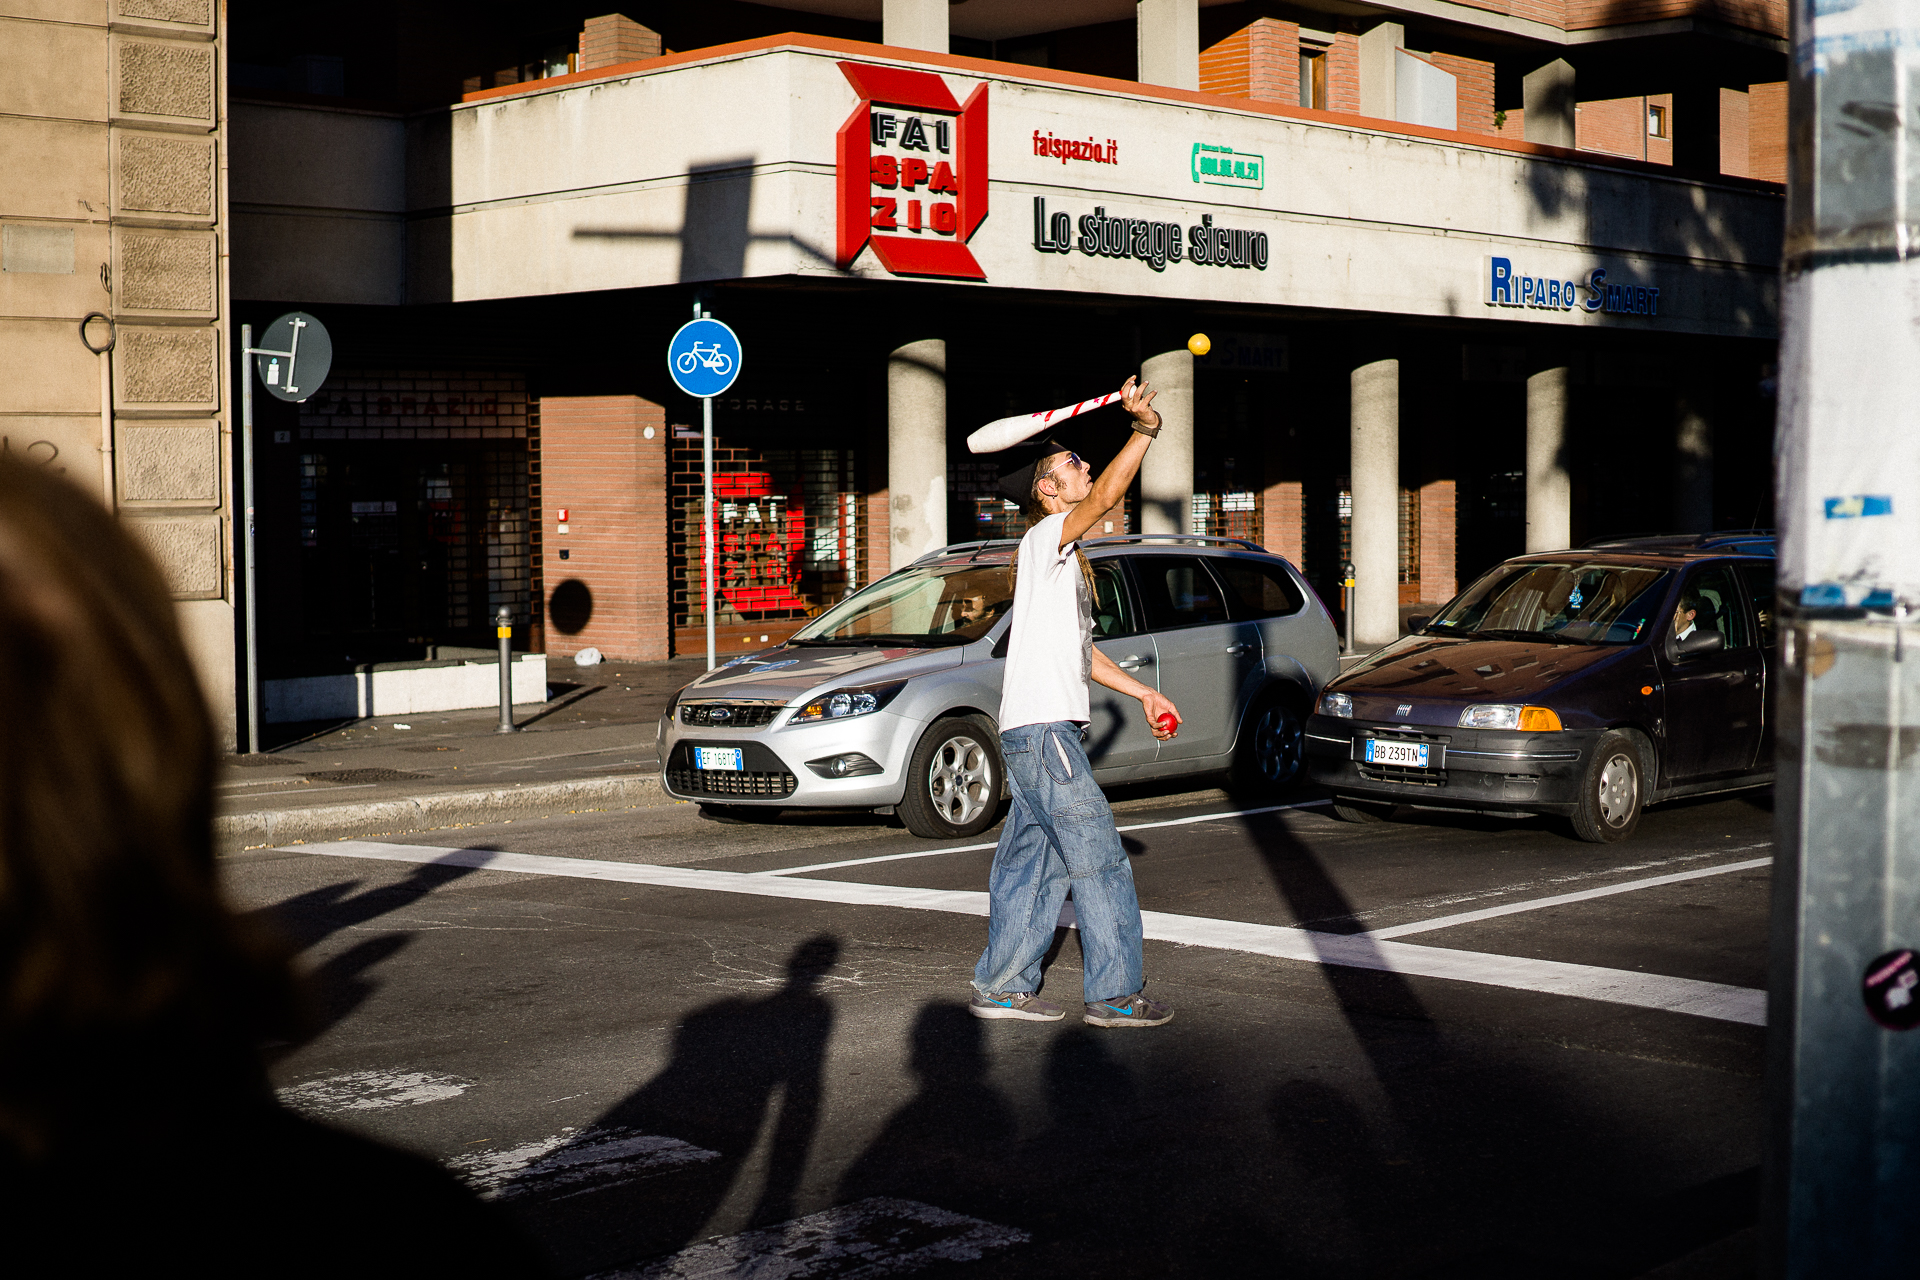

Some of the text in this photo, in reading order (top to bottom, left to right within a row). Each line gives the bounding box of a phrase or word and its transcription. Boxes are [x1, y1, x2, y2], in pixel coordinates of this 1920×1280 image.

[871, 112, 950, 154] FAI
[1032, 129, 1118, 165] faispazio.it
[871, 154, 958, 195] SPA
[871, 196, 957, 236] ZIO
[1035, 196, 1269, 272] Lo storage sicuro
[377, 396, 498, 415] SPAZIO
[723, 502, 778, 523] FAI
[1374, 744, 1386, 759] BB
[1388, 746, 1419, 762] 239TN
